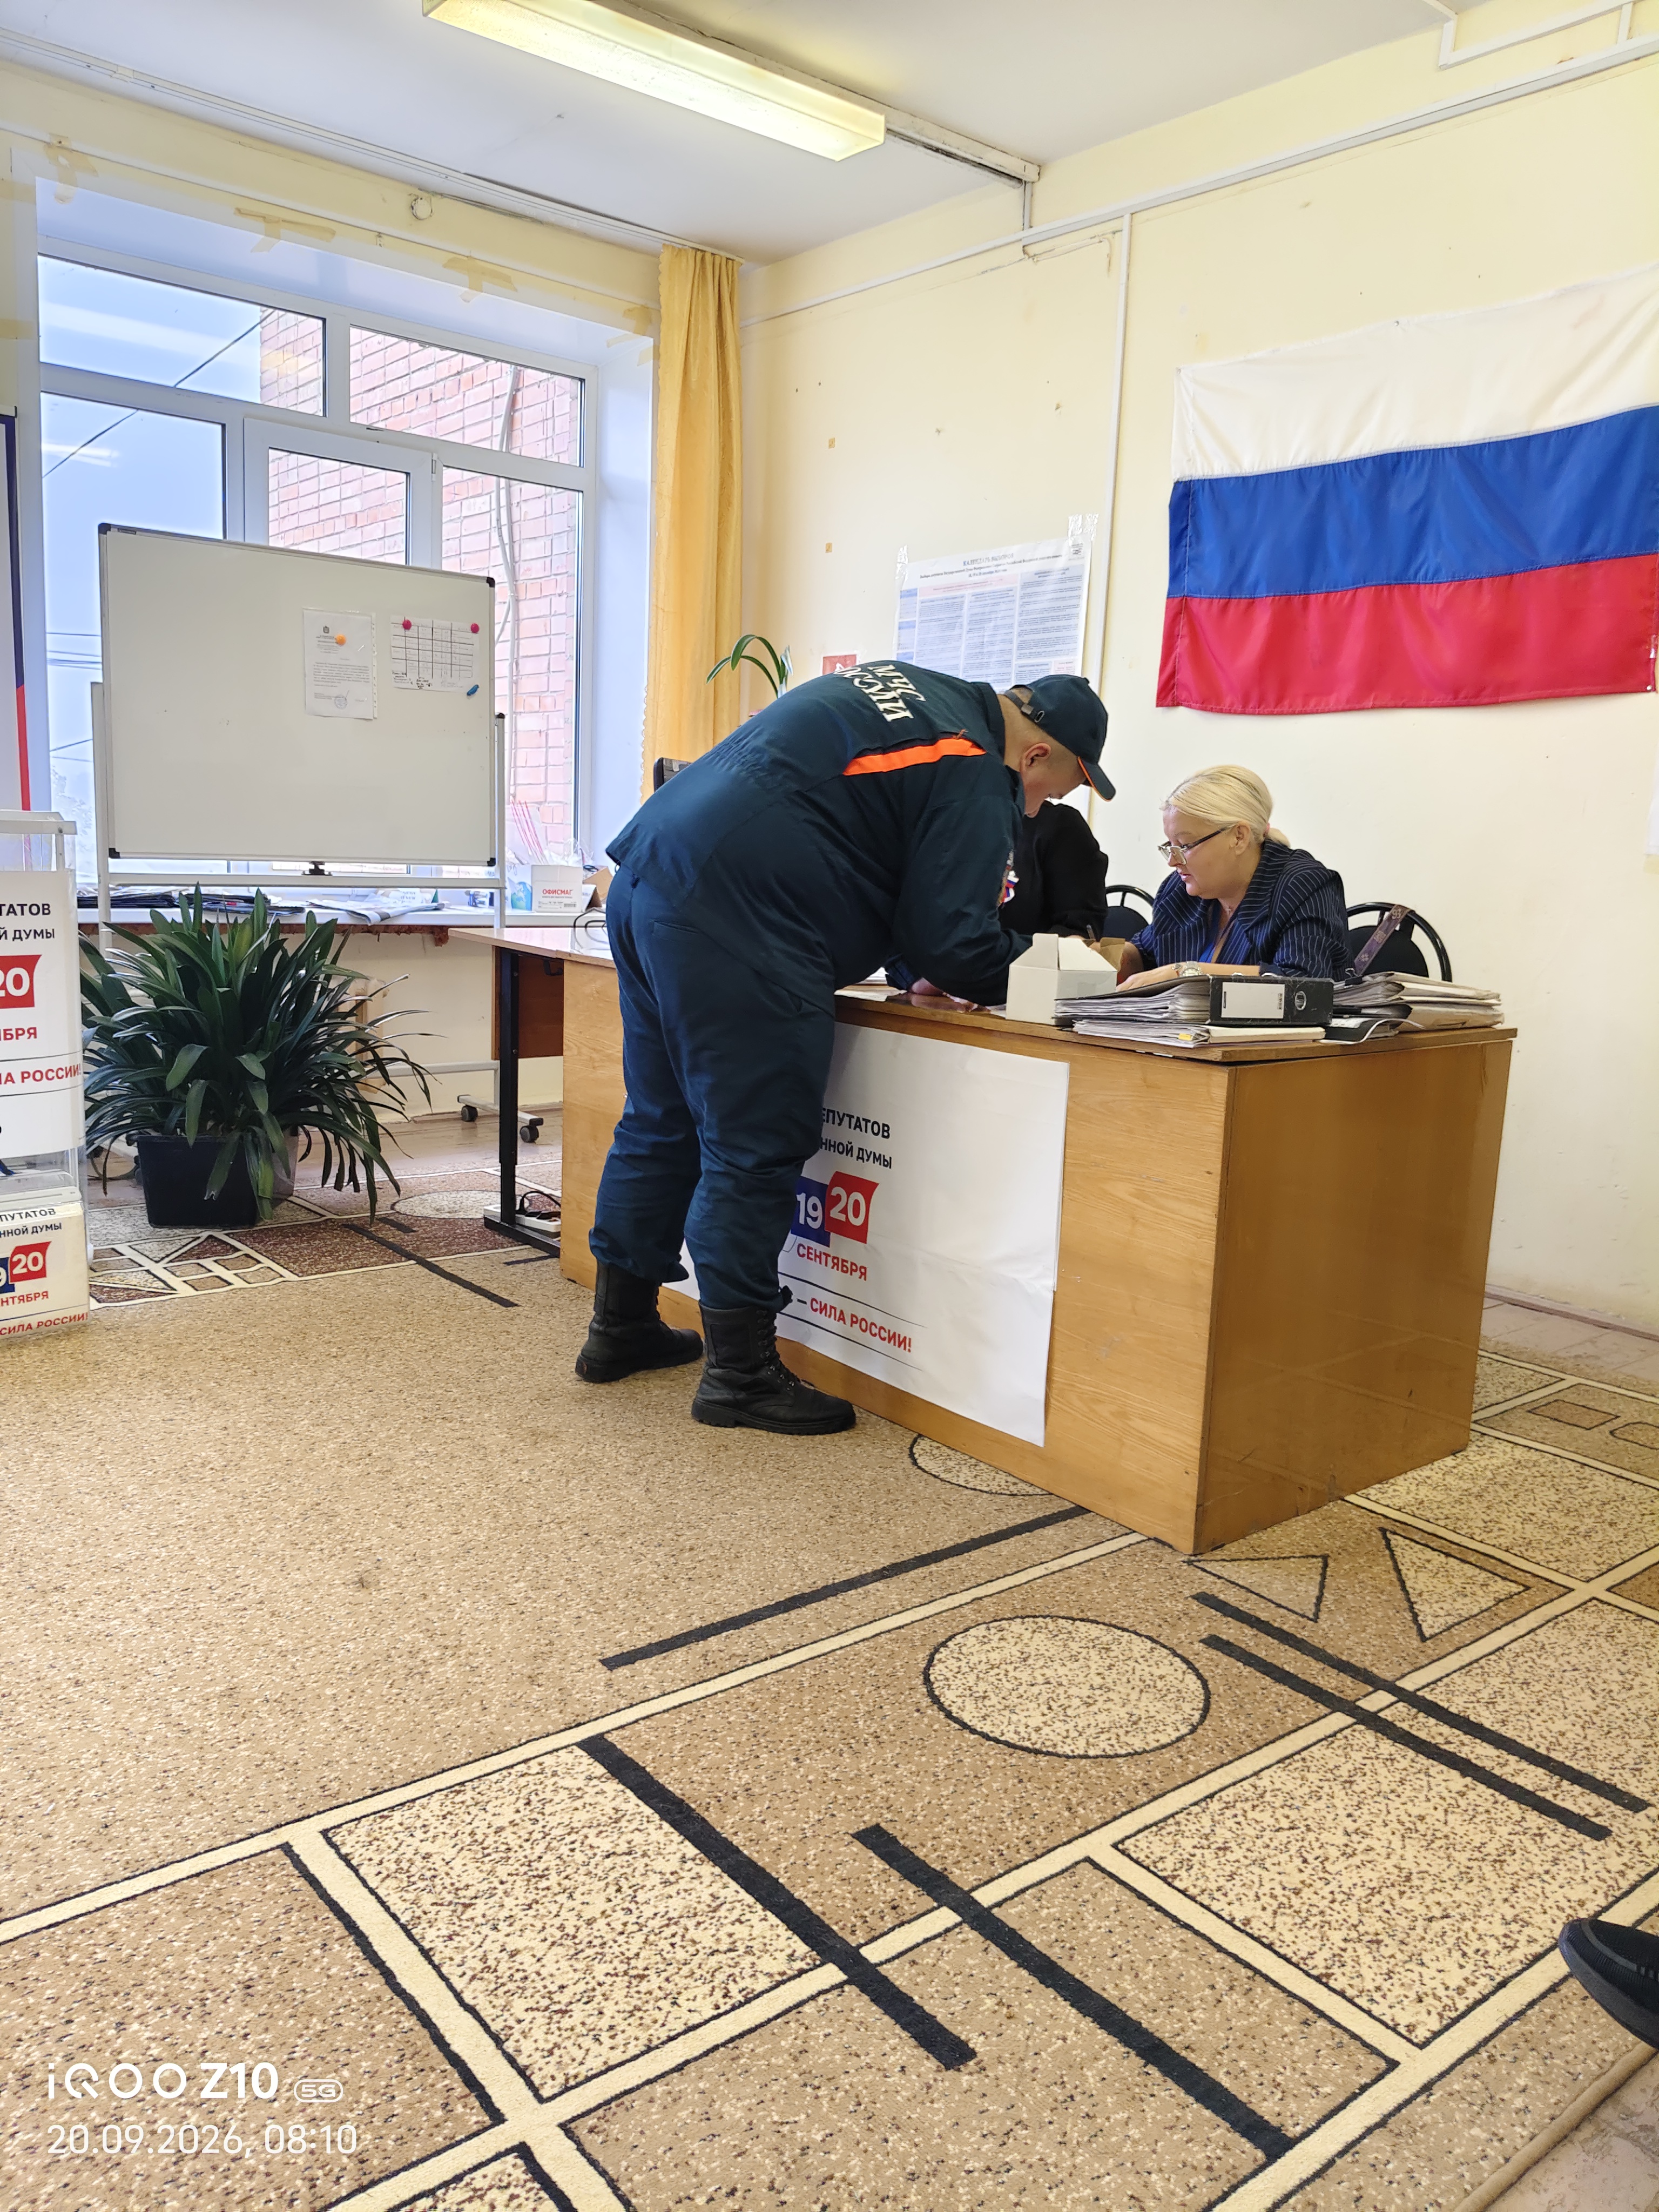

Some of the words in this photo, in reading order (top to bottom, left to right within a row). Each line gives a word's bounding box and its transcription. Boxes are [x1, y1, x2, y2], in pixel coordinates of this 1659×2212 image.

[833, 666, 914, 721] ОССИИ
[867, 664, 926, 702] МЧС
[12, 928, 55, 941] ДУМЫ
[0, 1027, 37, 1041] БРЯ
[820, 1137, 854, 1158] ННОЙ
[856, 1147, 892, 1170] ДУМЫ
[796, 1192, 823, 1229] 19
[830, 1186, 866, 1226] 20
[31, 1222, 62, 1235] ДУМЫ
[12, 1251, 44, 1274] 20
[797, 1243, 868, 1282] СЕНТЯБРЯ
[0, 1290, 49, 1307] НТЯБРЯ
[0, 1323, 33, 1336] СИЛА
[36, 1312, 89, 1329] РОССИИ!
[810, 1298, 846, 1325] СИЛА
[849, 1313, 912, 1353] РОССИИ!
